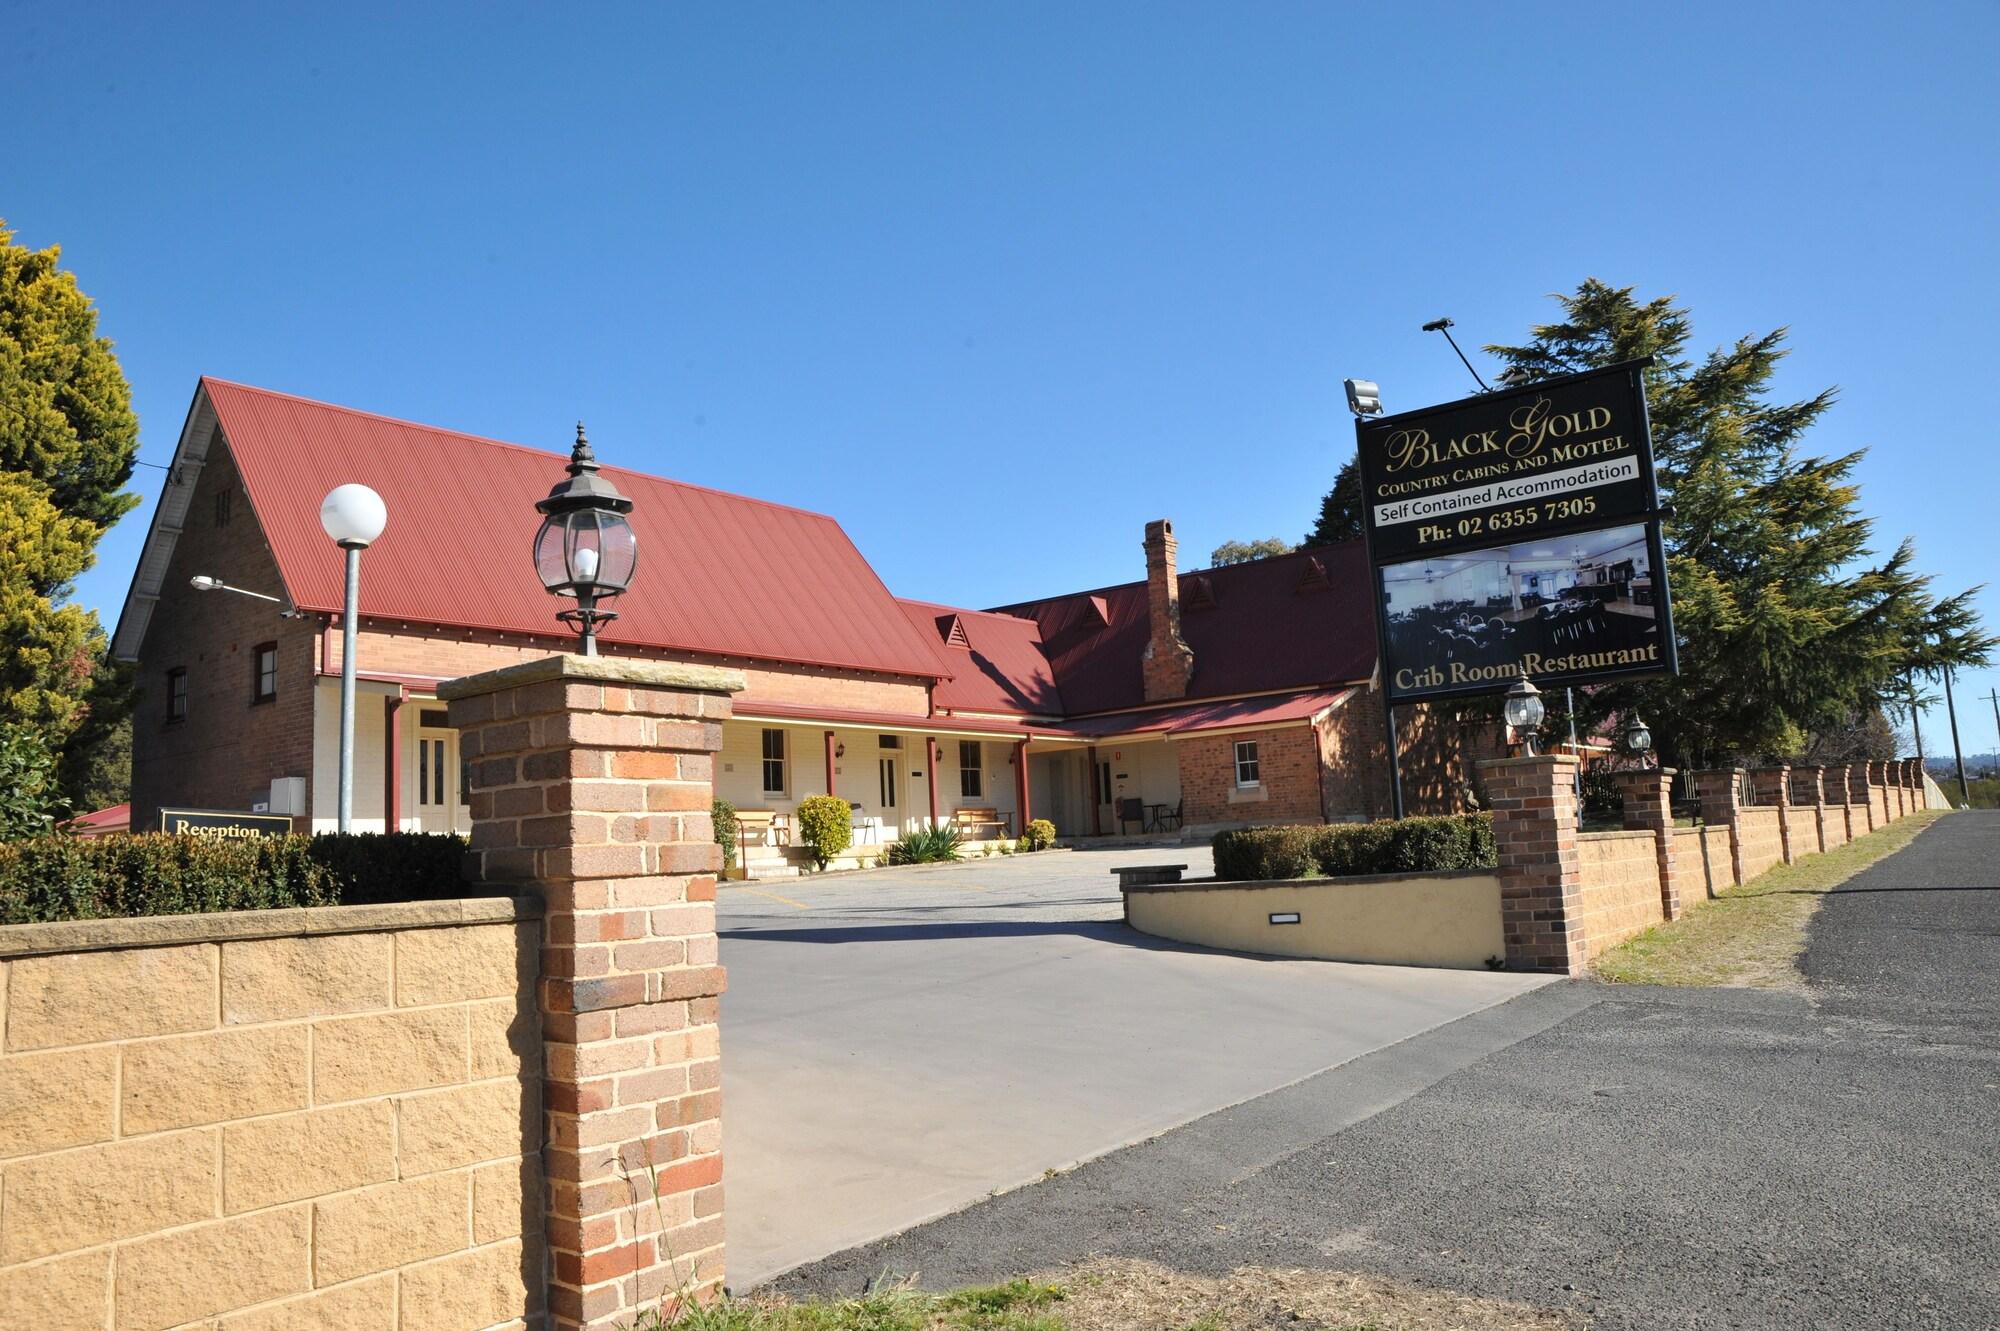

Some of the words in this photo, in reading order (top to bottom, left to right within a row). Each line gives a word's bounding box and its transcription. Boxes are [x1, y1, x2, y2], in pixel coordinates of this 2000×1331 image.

[1384, 428, 1501, 472] BLACK
[1505, 393, 1611, 459] GOLD
[1377, 474, 1450, 497] COUNTRY
[1453, 462, 1510, 483] CABINS
[1514, 454, 1548, 471] AND
[1552, 436, 1629, 464] MOTEL
[1380, 506, 1409, 522] Self
[1412, 492, 1492, 516] Contained
[1496, 463, 1632, 501] Accommodation
[1417, 525, 1452, 544] Ph:
[1458, 517, 1482, 536] 02
[1489, 506, 1538, 531] 6355
[1545, 496, 1596, 521] 7305
[1395, 664, 1444, 690] Crib
[1450, 661, 1518, 683] Room
[1522, 643, 1658, 675] Restaurant
[176, 820, 260, 840] Reception
